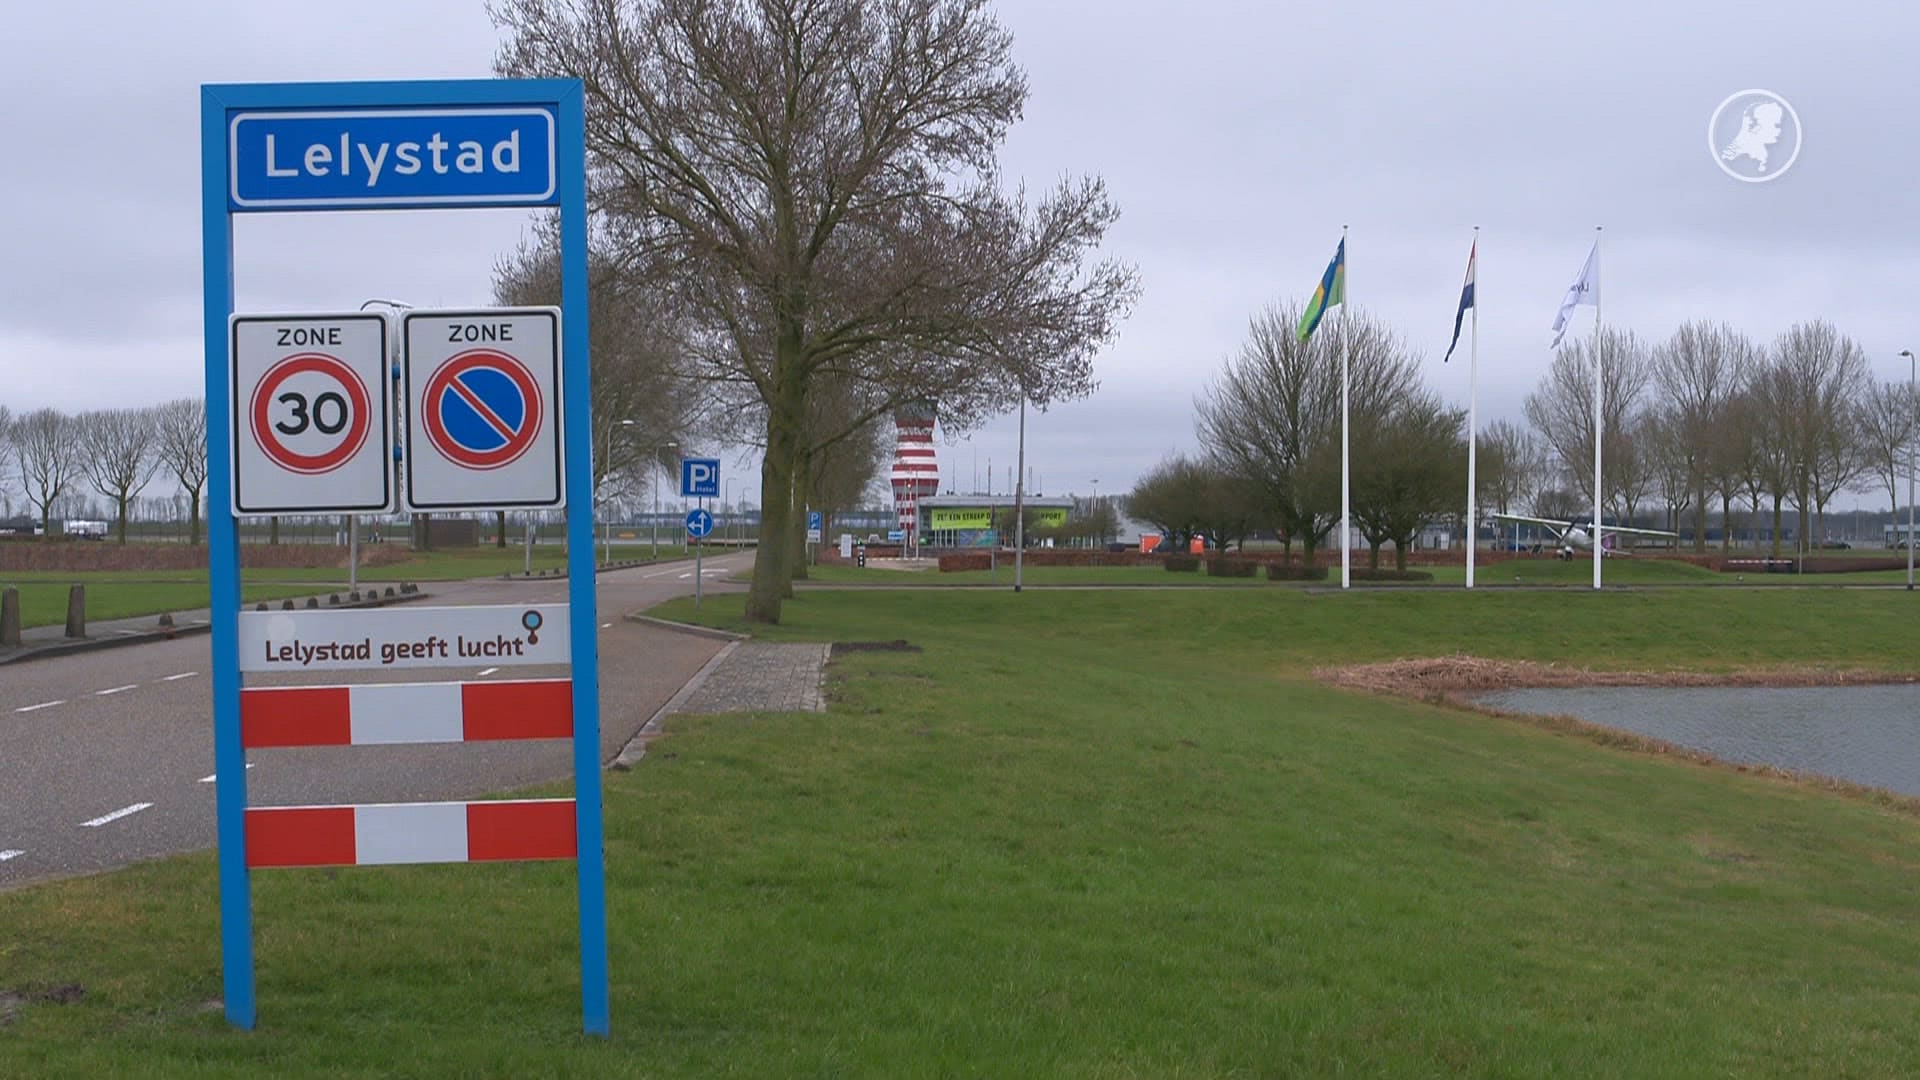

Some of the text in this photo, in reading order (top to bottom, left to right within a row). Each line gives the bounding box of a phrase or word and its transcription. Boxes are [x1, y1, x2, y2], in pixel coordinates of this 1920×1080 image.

[265, 128, 521, 188] Lelystad
[276, 327, 342, 347] ZONE
[448, 323, 514, 343] ZONE
[274, 391, 349, 436] 30
[690, 463, 711, 493] P
[810, 512, 819, 523] P
[264, 635, 524, 666] Lelystad geeft lucht
